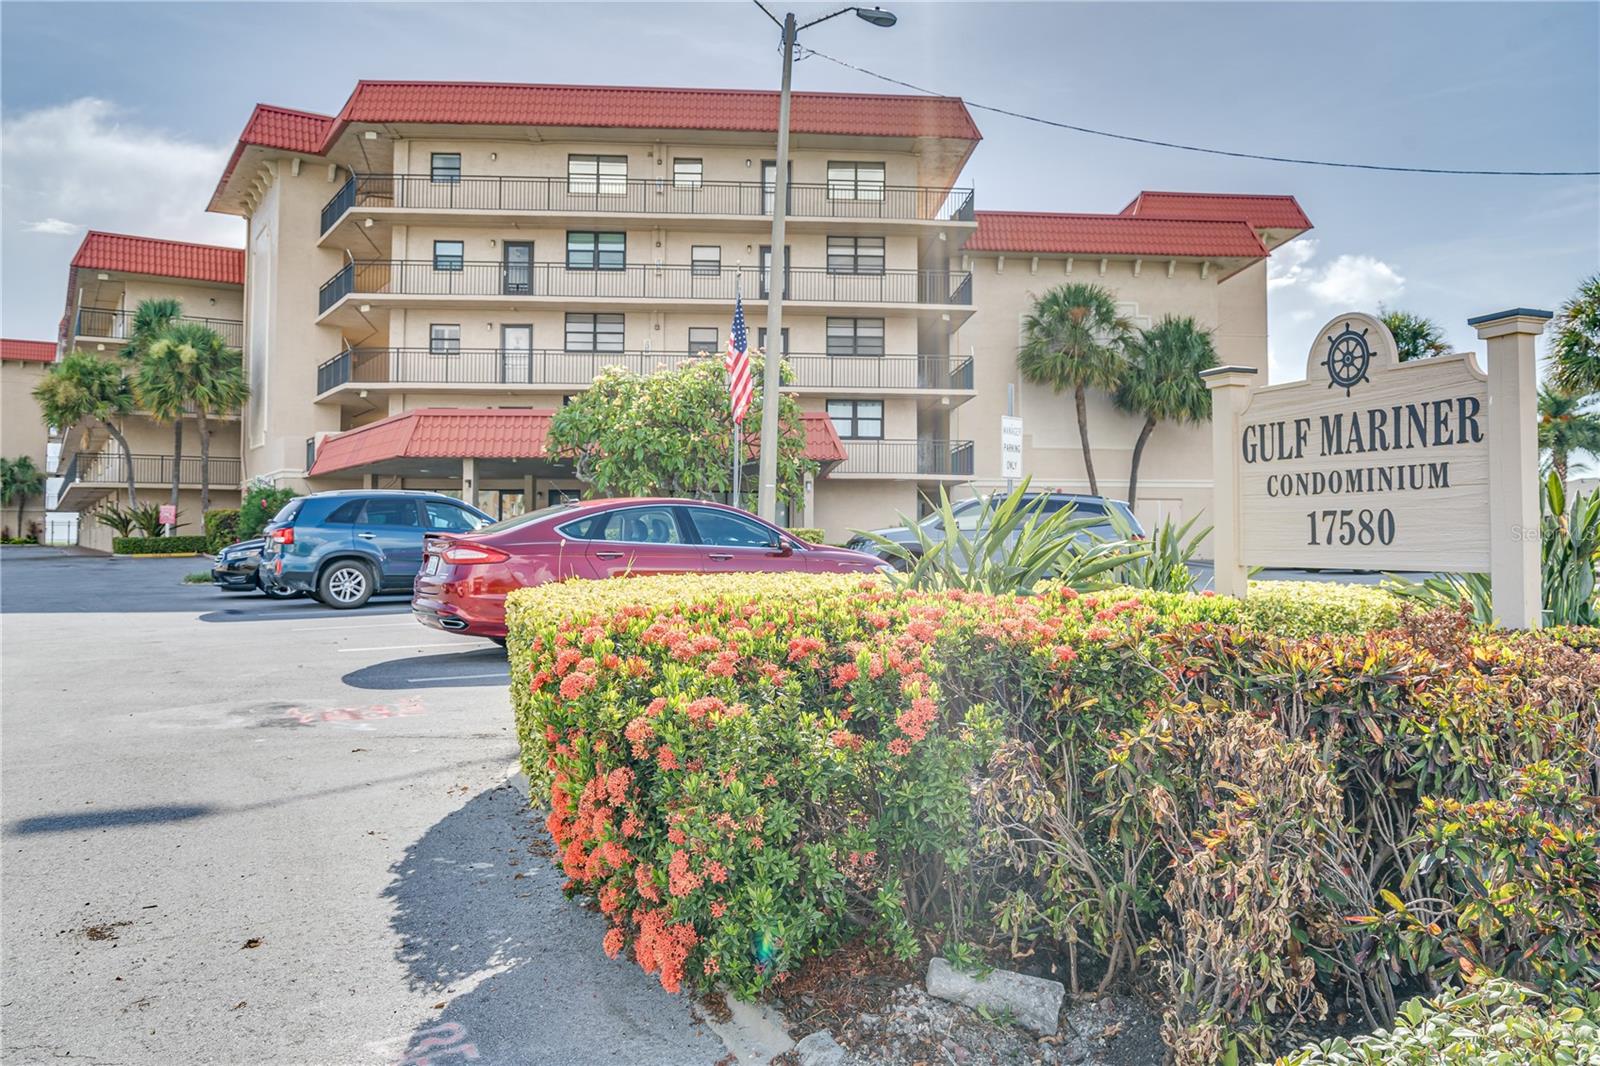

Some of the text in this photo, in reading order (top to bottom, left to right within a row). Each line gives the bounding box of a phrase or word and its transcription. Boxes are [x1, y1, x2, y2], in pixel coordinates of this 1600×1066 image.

[1242, 396, 1484, 463] GULF MARINER
[1267, 462, 1450, 497] CONDOMINIUM
[1306, 508, 1396, 545] 17580
